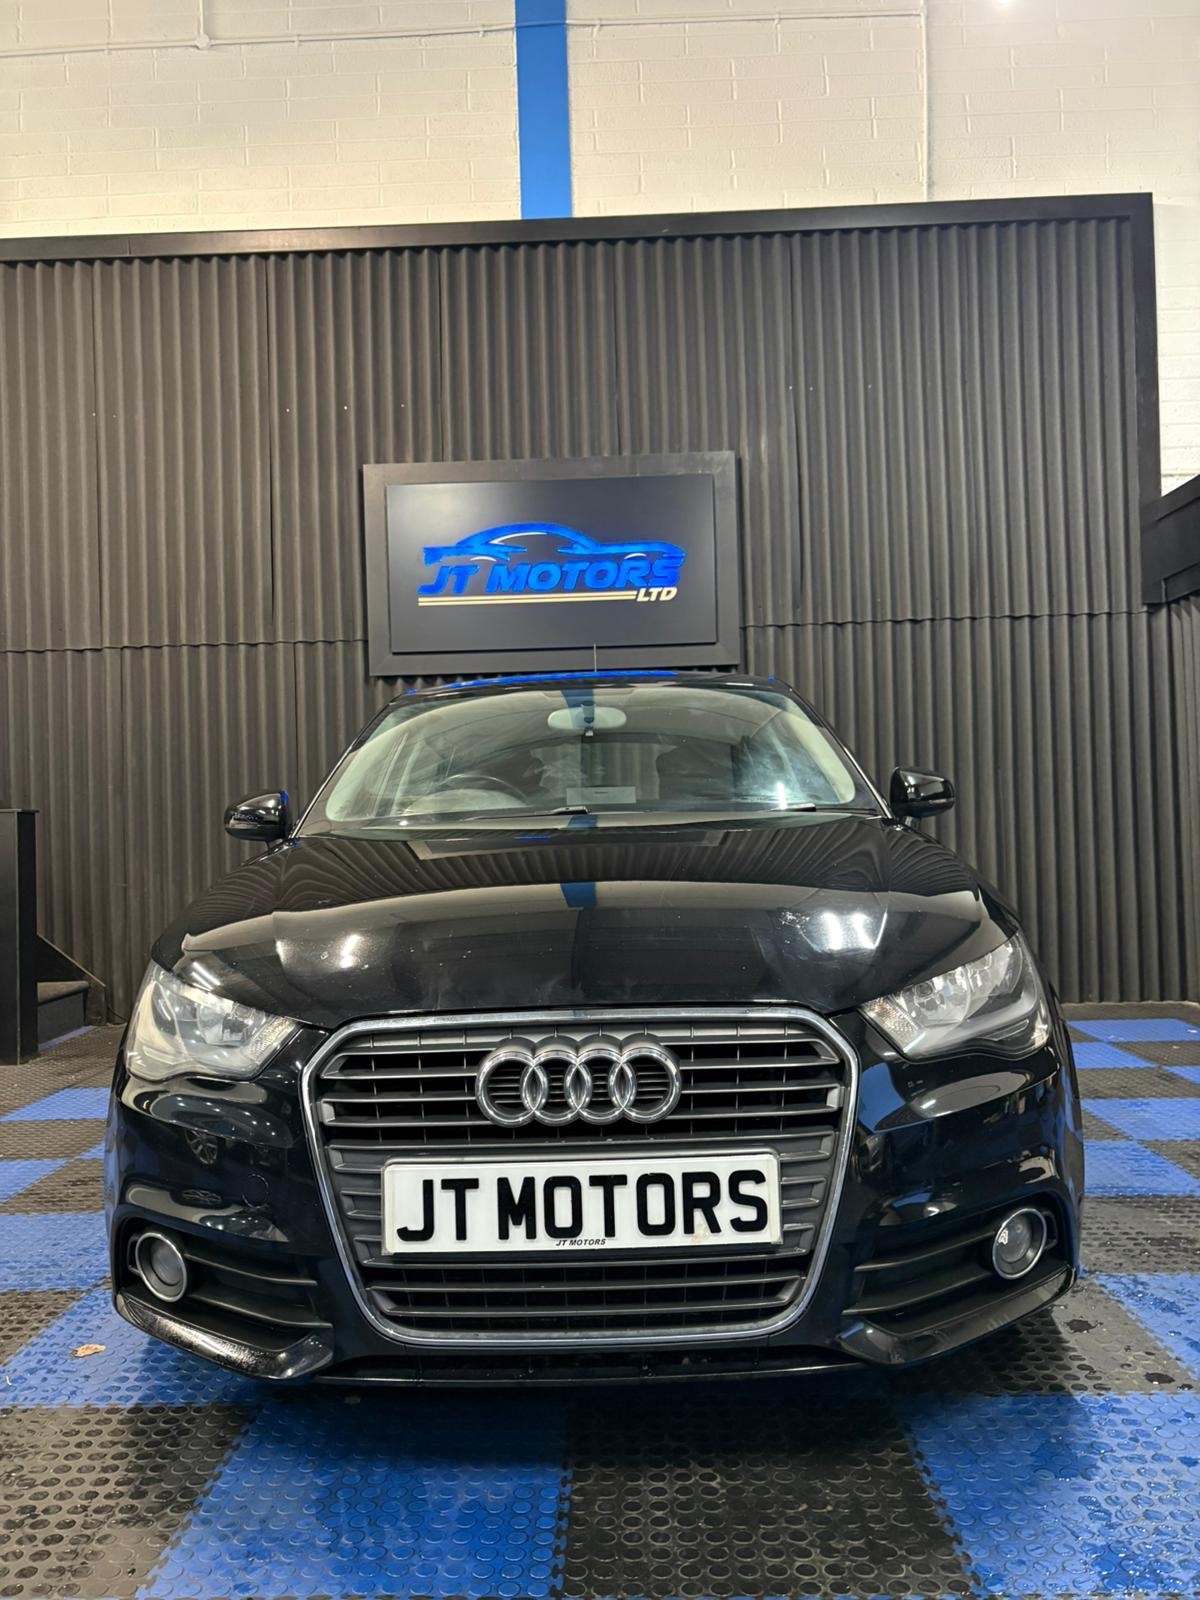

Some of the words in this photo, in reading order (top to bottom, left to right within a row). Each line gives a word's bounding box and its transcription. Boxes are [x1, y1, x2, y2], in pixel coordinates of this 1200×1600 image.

[418, 565, 480, 594] JT
[486, 558, 681, 592] MOTORS
[636, 587, 678, 603] LTD
[396, 1177, 480, 1242] JT
[496, 1169, 769, 1240] MOTORS
